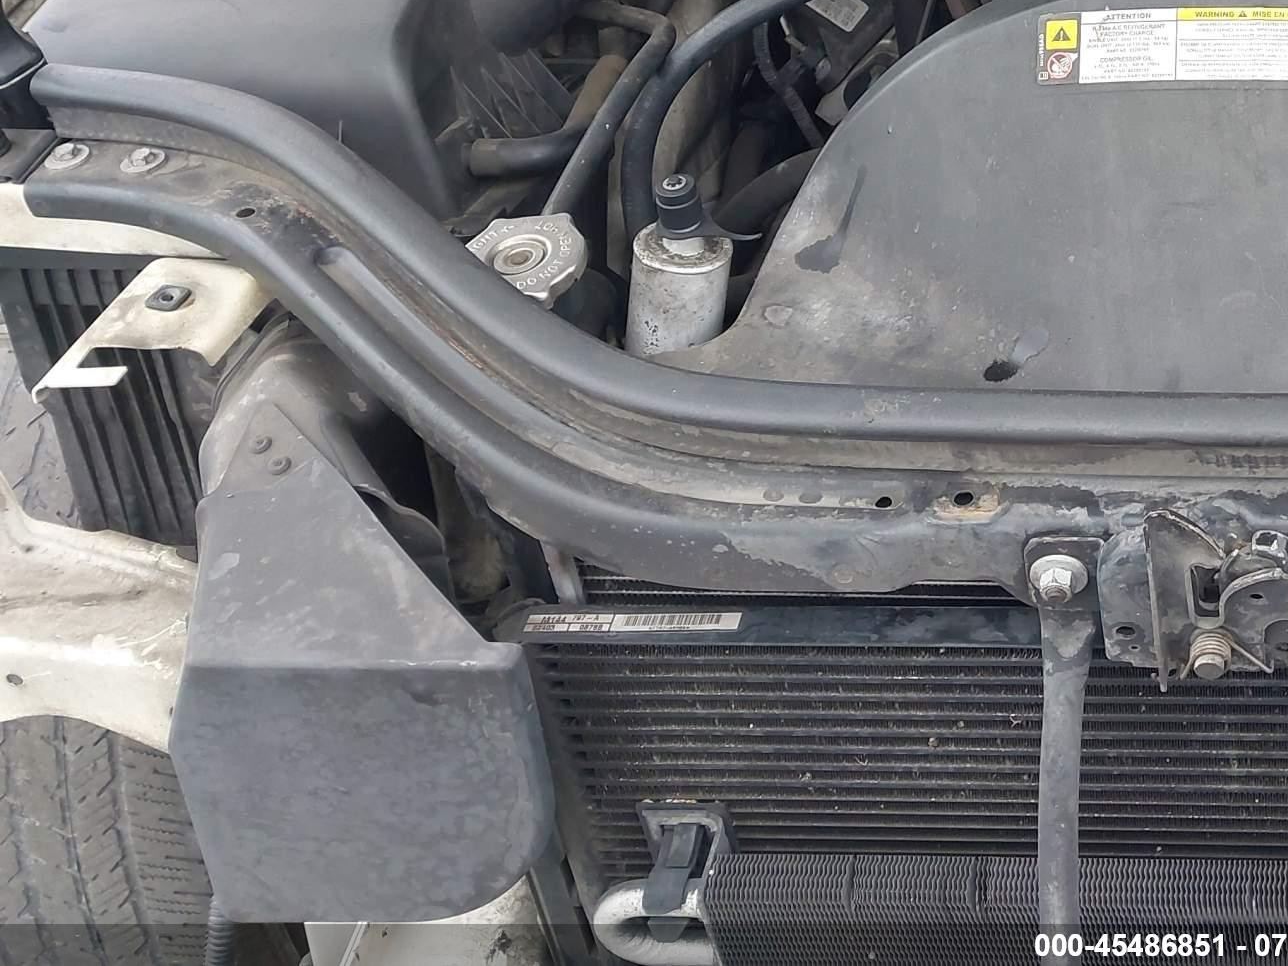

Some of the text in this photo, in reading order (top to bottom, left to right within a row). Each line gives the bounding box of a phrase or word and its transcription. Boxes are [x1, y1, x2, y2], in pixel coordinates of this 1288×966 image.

[1194, 10, 1235, 19] WARNING
[1273, 11, 1286, 19] EN
[516, 277, 537, 290] DO
[539, 258, 564, 280] NOT
